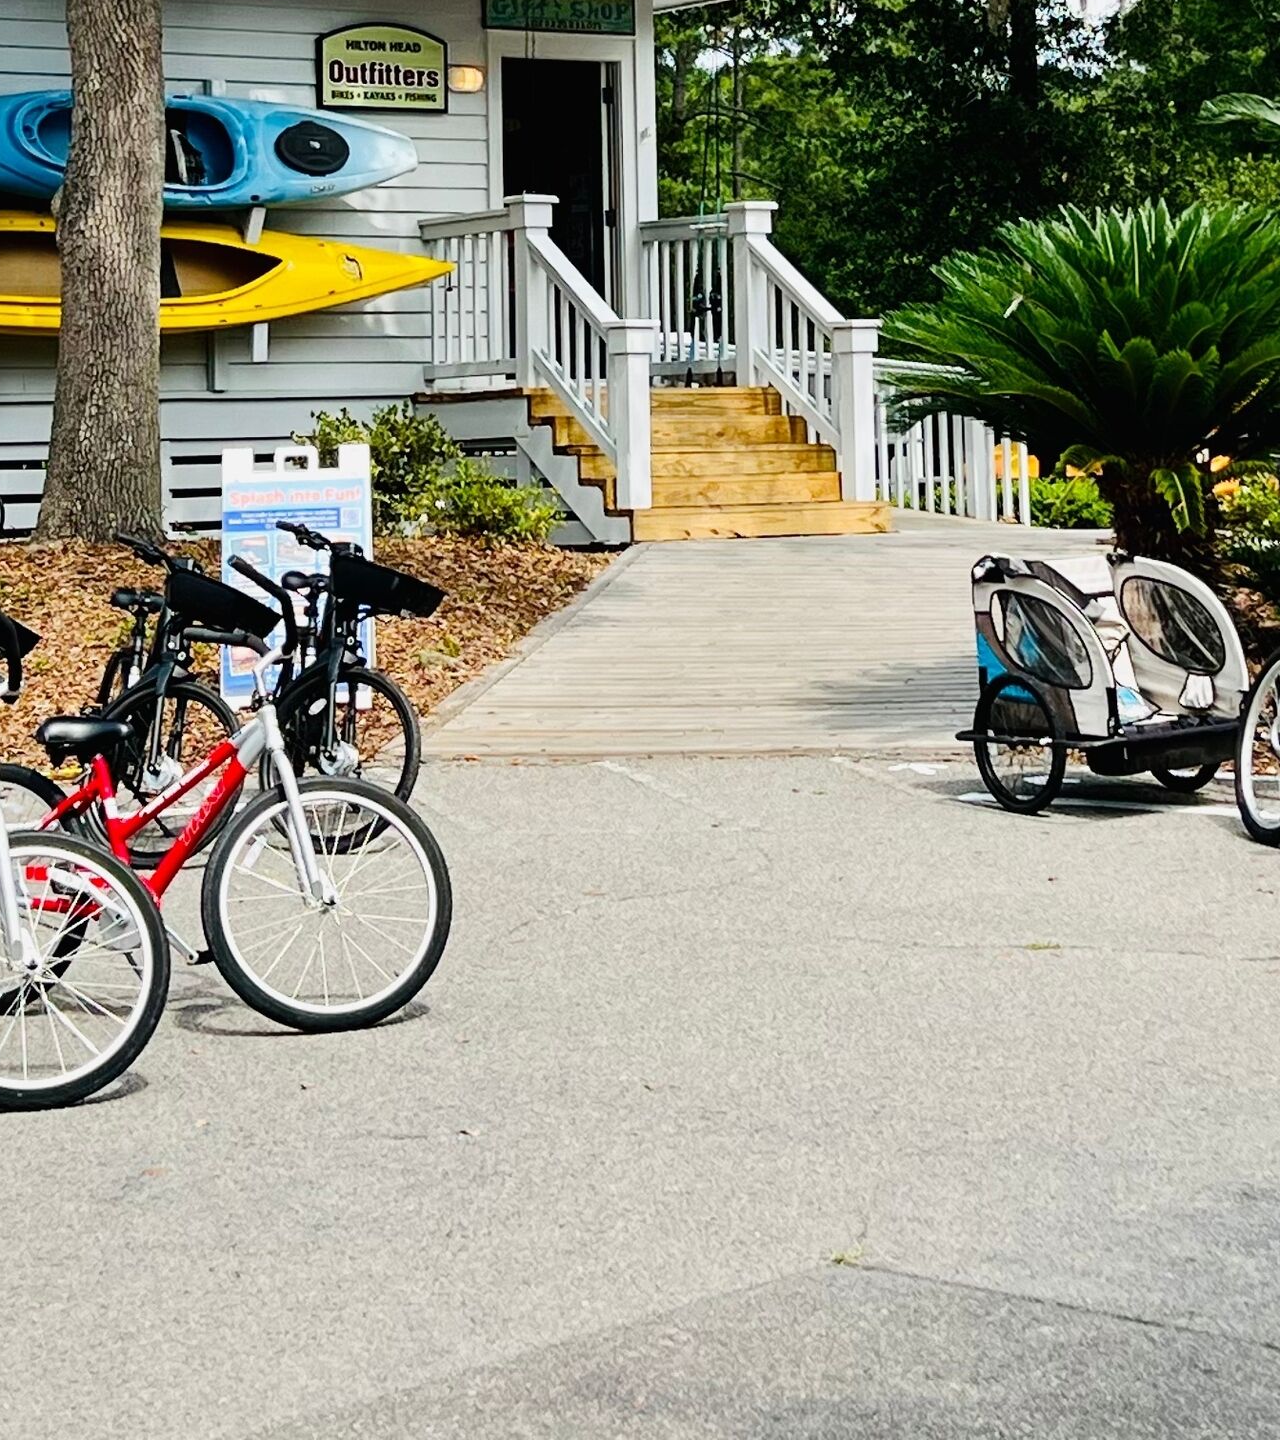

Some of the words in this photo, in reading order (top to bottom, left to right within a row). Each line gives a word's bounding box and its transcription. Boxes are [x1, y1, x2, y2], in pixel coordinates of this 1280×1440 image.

[346, 40, 386, 52] HILTON
[389, 42, 422, 53] HEAD
[329, 59, 439, 88] Outfitters
[331, 90, 354, 100] BIKES
[363, 91, 396, 101] KAYAKS
[404, 93, 437, 103] FISHING
[230, 489, 285, 508] Splash
[325, 486, 362, 501] Fun!
